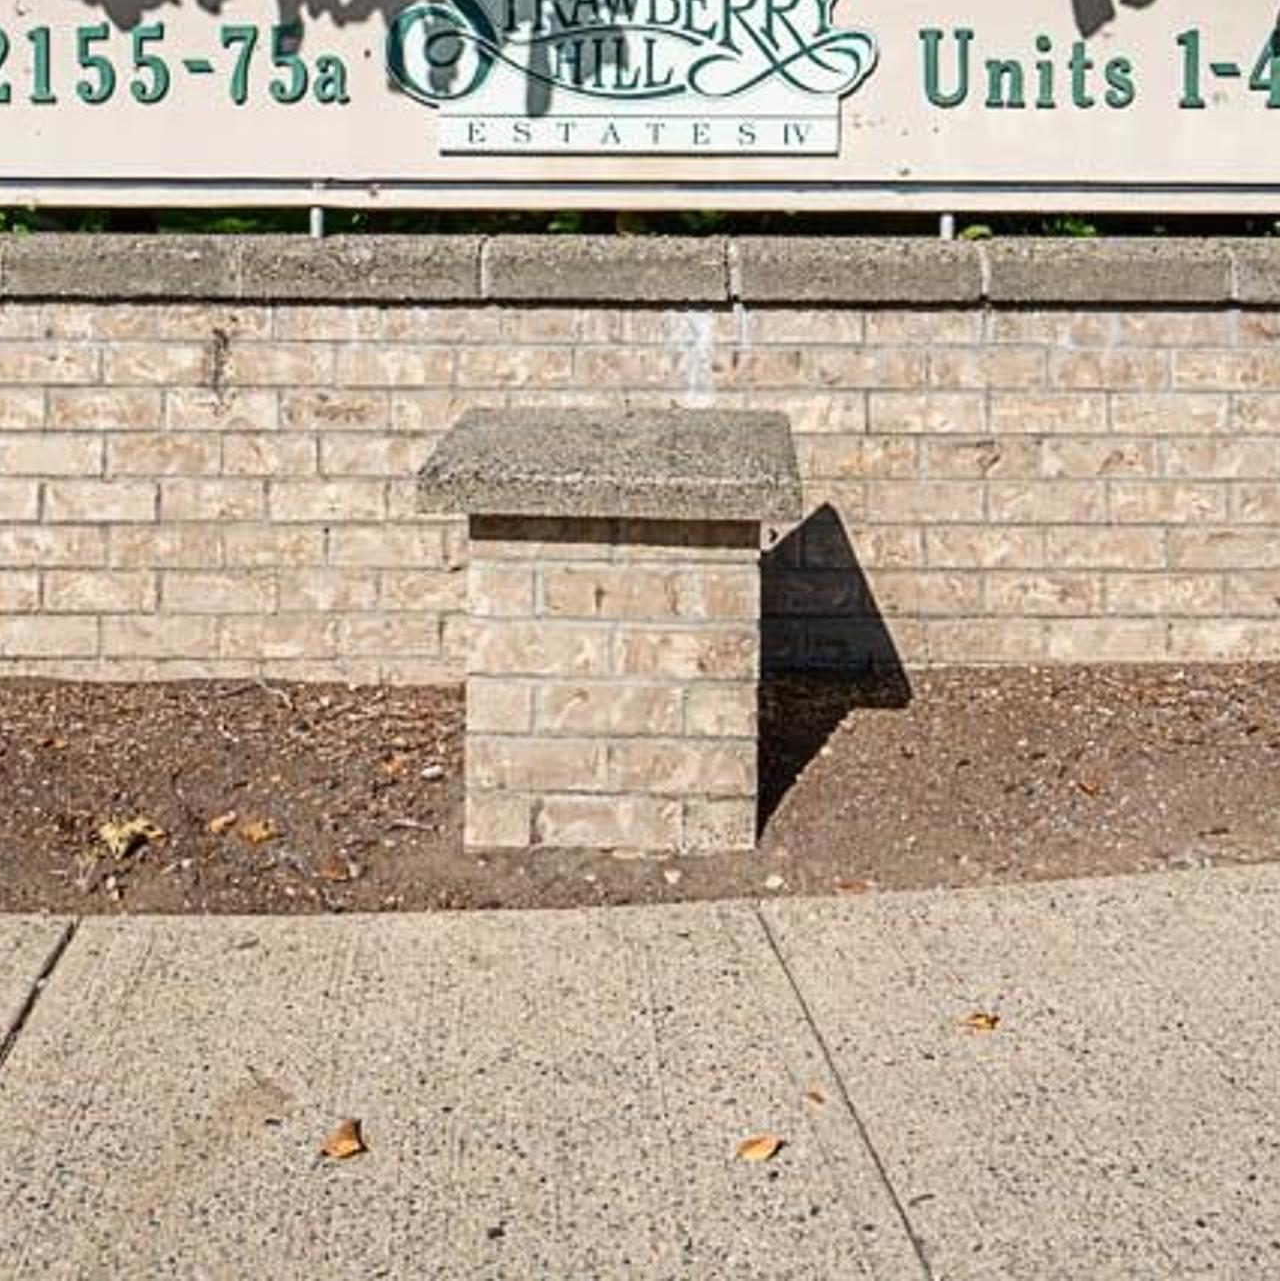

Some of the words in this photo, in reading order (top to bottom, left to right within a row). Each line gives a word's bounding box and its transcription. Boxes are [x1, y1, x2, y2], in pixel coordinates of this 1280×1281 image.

[552, 36, 677, 90] HILL
[919, 28, 1136, 110] Units
[467, 122, 757, 145] ESTATES
[782, 122, 813, 145] IV
